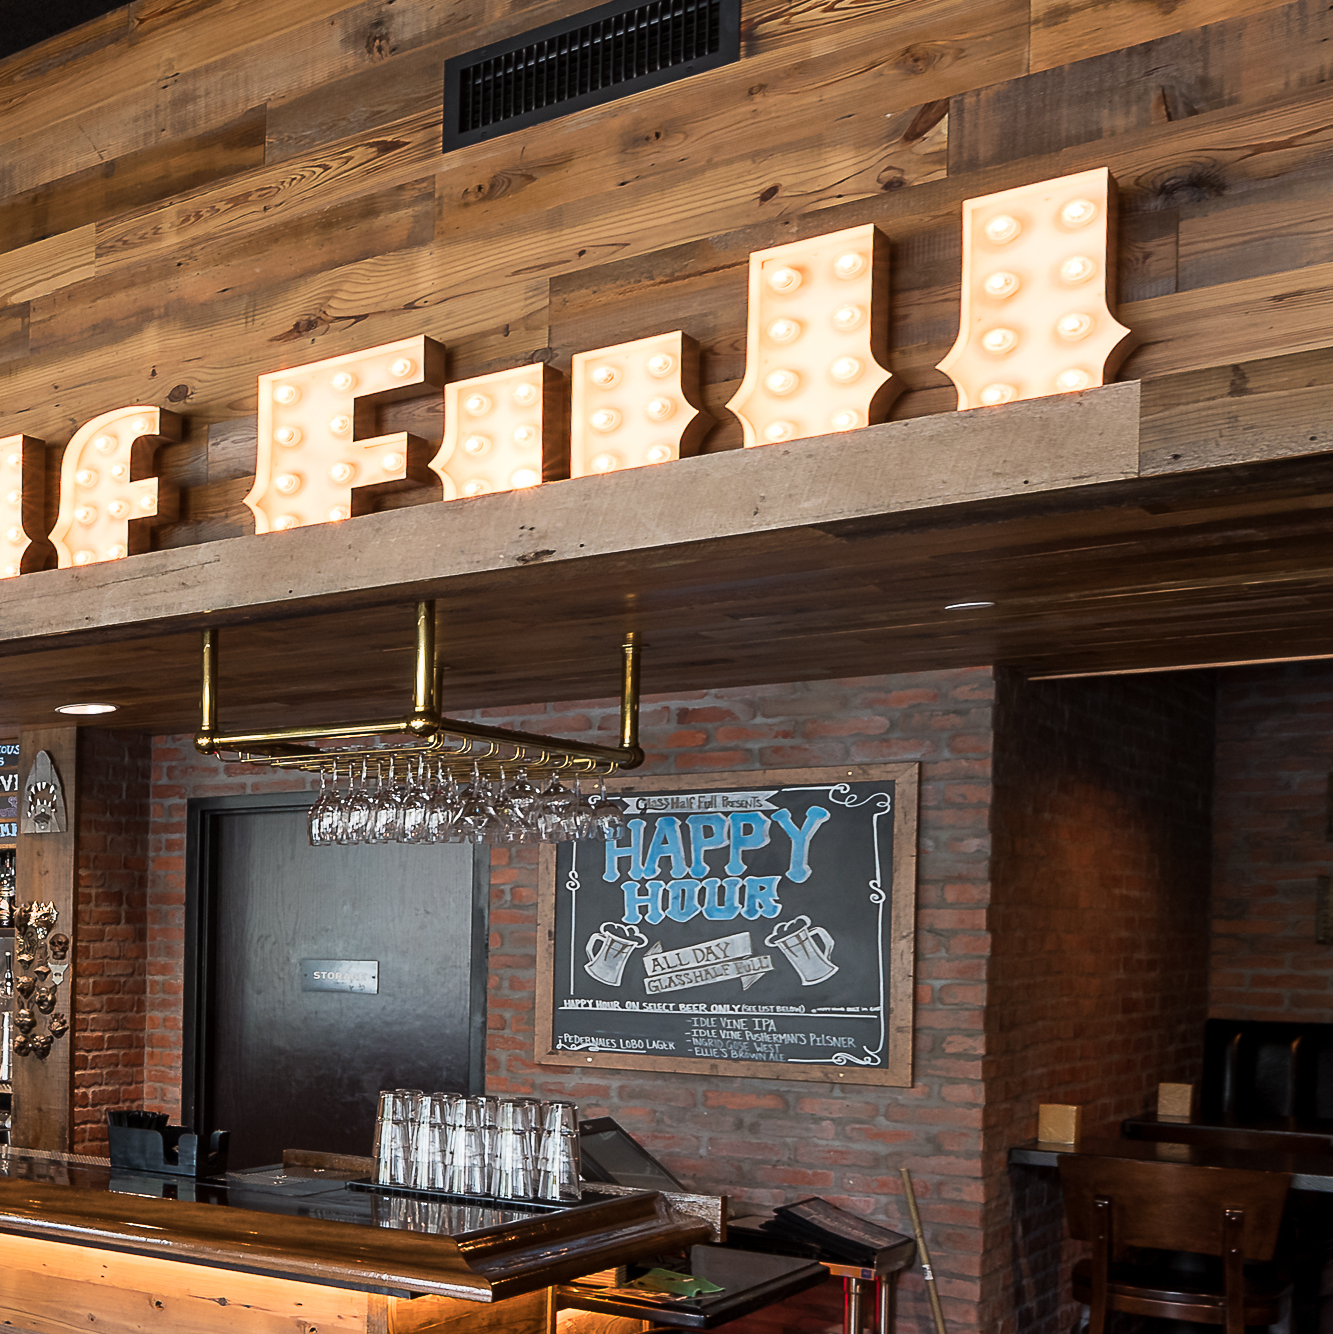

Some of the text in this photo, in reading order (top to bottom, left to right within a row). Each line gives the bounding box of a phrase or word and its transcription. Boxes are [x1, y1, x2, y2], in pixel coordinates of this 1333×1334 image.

[602, 805, 831, 884] HAPPY
[620, 875, 783, 926] HOUR
[651, 941, 731, 973] ALL DAY
[647, 972, 694, 993] GLASS
[693, 963, 731, 984] HALF
[563, 999, 594, 1009] HAPPY
[595, 1000, 622, 1010] HOUR
[625, 1001, 640, 1010] ON
[642, 1002, 676, 1012] SELECT
[678, 1003, 708, 1013] BEER
[710, 1004, 742, 1014] ONLY
[721, 1018, 748, 1030] VINE
[752, 1018, 777, 1032] IPA
[719, 1030, 744, 1041] VINE
[619, 1039, 644, 1049] LOBO
[646, 1039, 676, 1050] LAGER
[726, 1040, 749, 1050] GOSE
[753, 1042, 782, 1053] WEST
[730, 1050, 768, 1060] BROWN
[769, 1052, 786, 1062] ALE
